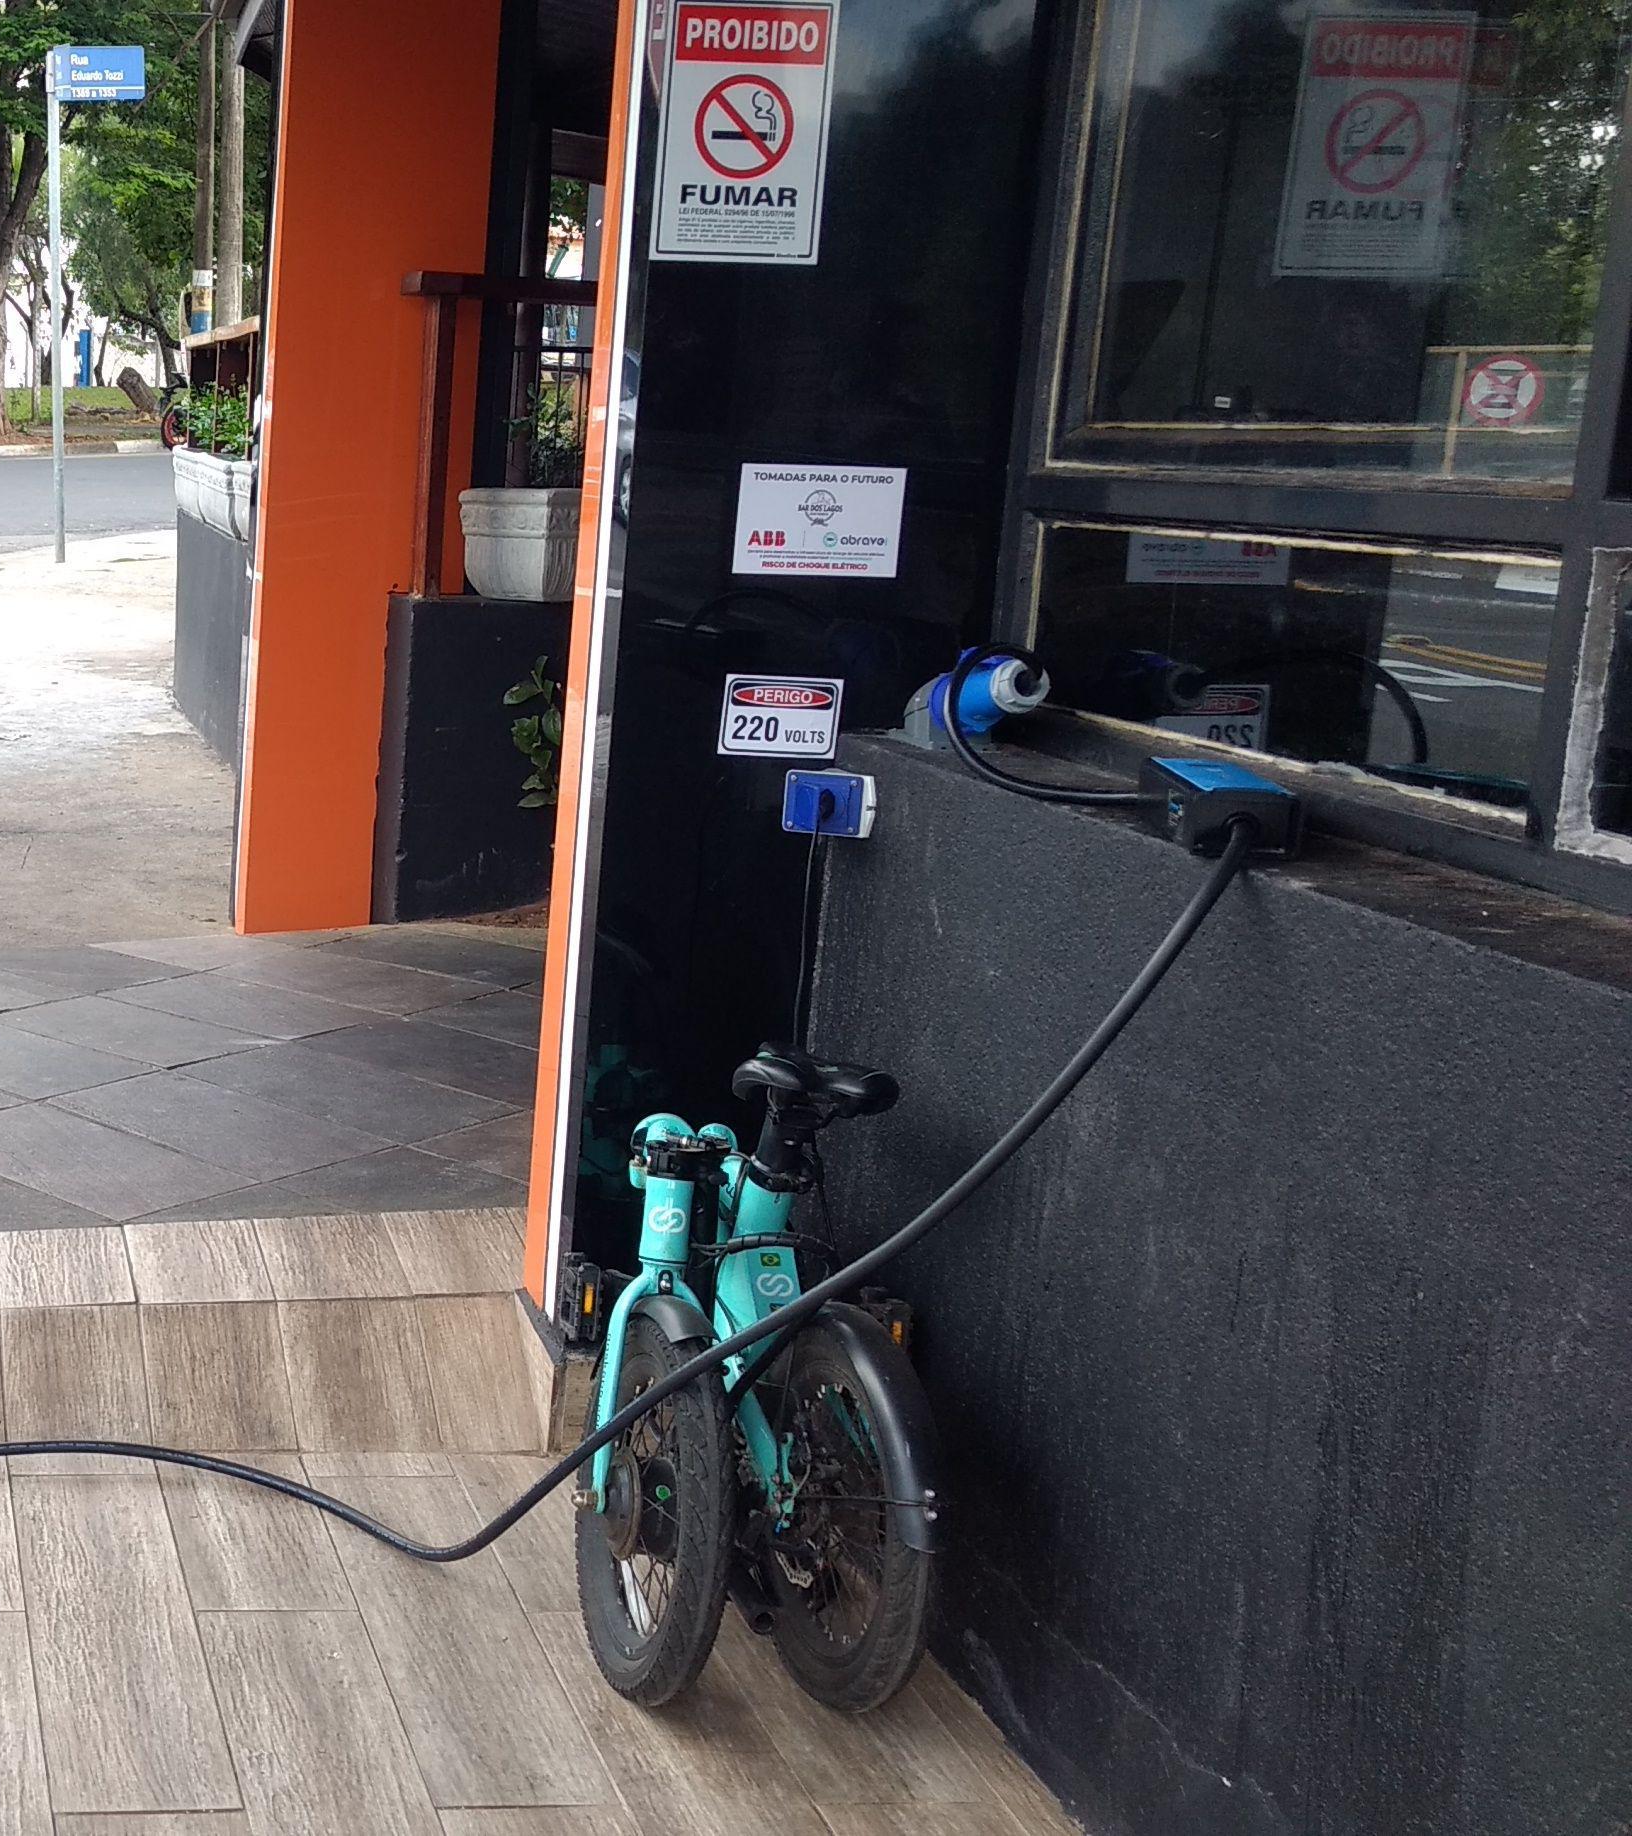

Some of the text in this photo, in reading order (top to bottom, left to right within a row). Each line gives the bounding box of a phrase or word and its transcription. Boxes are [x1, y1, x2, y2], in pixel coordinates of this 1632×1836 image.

[684, 17, 820, 53] PROIBIDO
[70, 53, 89, 66] Rua
[71, 69, 124, 81] Eduardo Tozzi
[679, 183, 798, 208] FUMAR
[678, 207, 690, 215] LEI
[690, 208, 723, 216] FEDERAL
[753, 471, 895, 485] TOMADAS PARA O FUTURO
[747, 530, 786, 547] ABB
[761, 560, 785, 568] RISCO
[786, 561, 797, 569] DE
[798, 561, 830, 570] CHOQUE
[753, 688, 813, 704] PERIGO
[731, 714, 826, 744] 220 VOLTS
